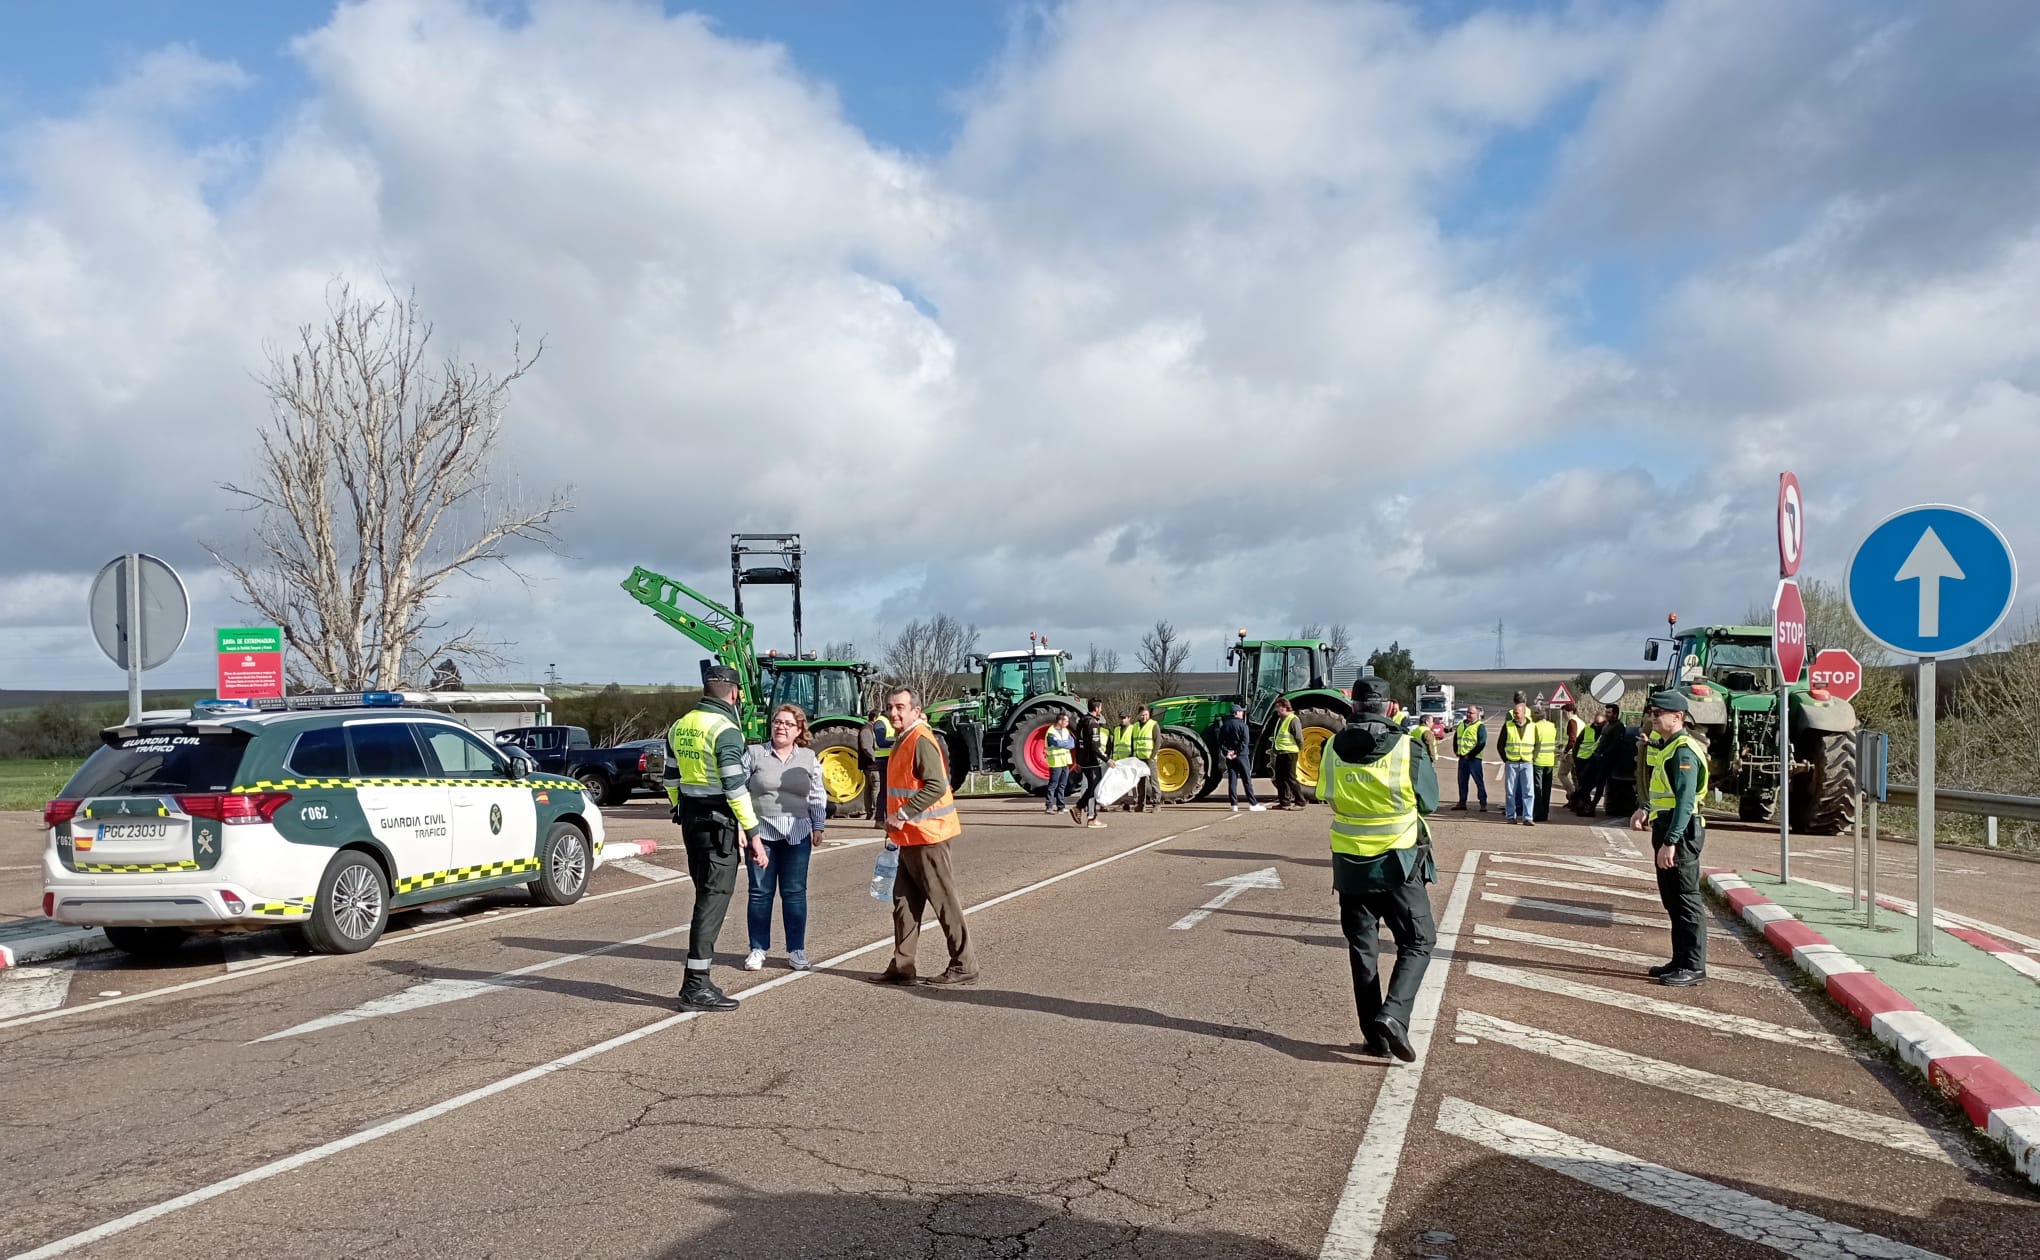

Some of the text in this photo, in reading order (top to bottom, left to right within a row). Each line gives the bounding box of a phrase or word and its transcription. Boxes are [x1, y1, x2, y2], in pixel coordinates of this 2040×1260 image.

[1779, 621, 1803, 644] STOP
[1812, 671, 1855, 684] STOP
[675, 728, 704, 738] GUARDIA
[122, 737, 200, 747] GUARDIA CIVIL
[1345, 773, 1376, 783] CIVIL
[308, 807, 328, 820] 062
[380, 814, 446, 829] GUARDIA CIVIL
[103, 823, 167, 838] PGC 2303 U
